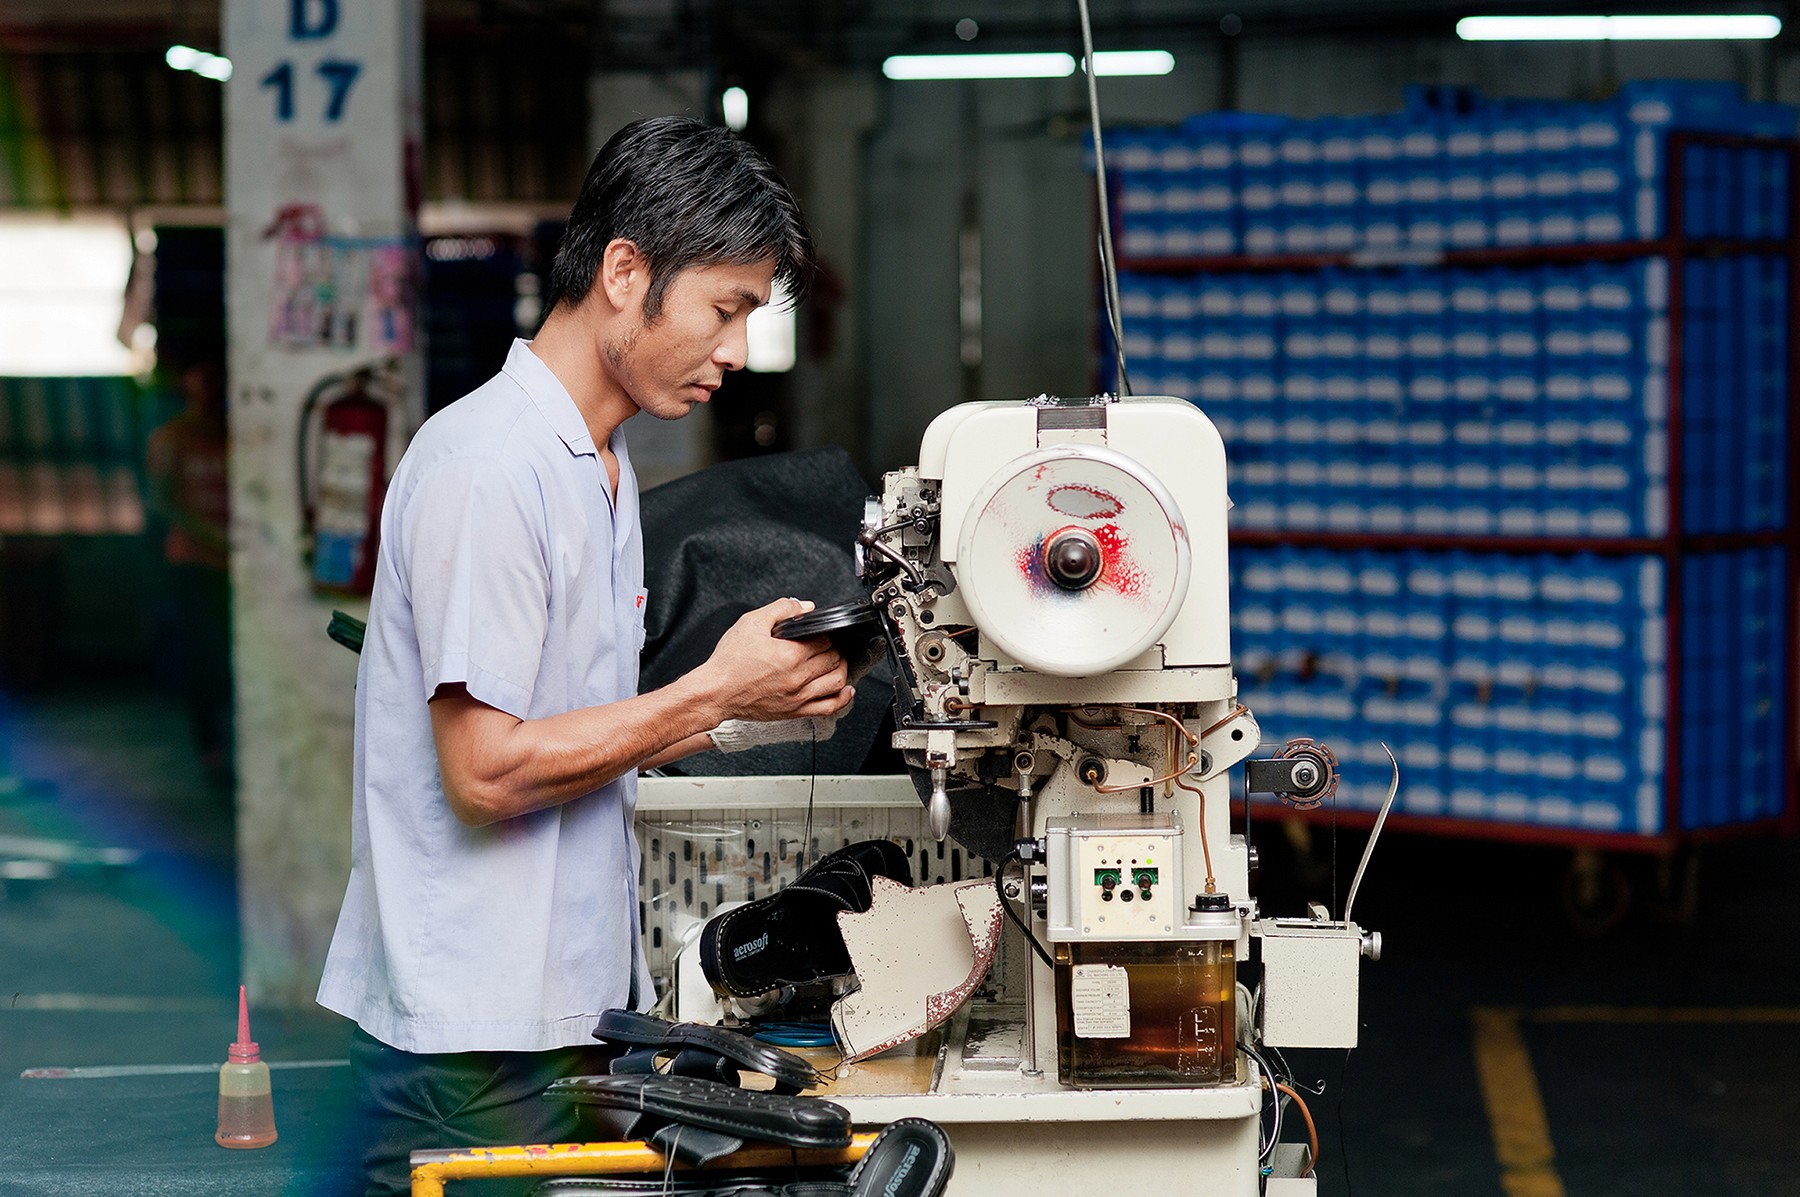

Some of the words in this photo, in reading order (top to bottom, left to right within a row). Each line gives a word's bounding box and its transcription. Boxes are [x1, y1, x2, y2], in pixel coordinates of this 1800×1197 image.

[290, 0, 339, 39] D
[261, 62, 361, 121] 17
[733, 932, 769, 958] aerosoft
[883, 1143, 921, 1197] aerosof
